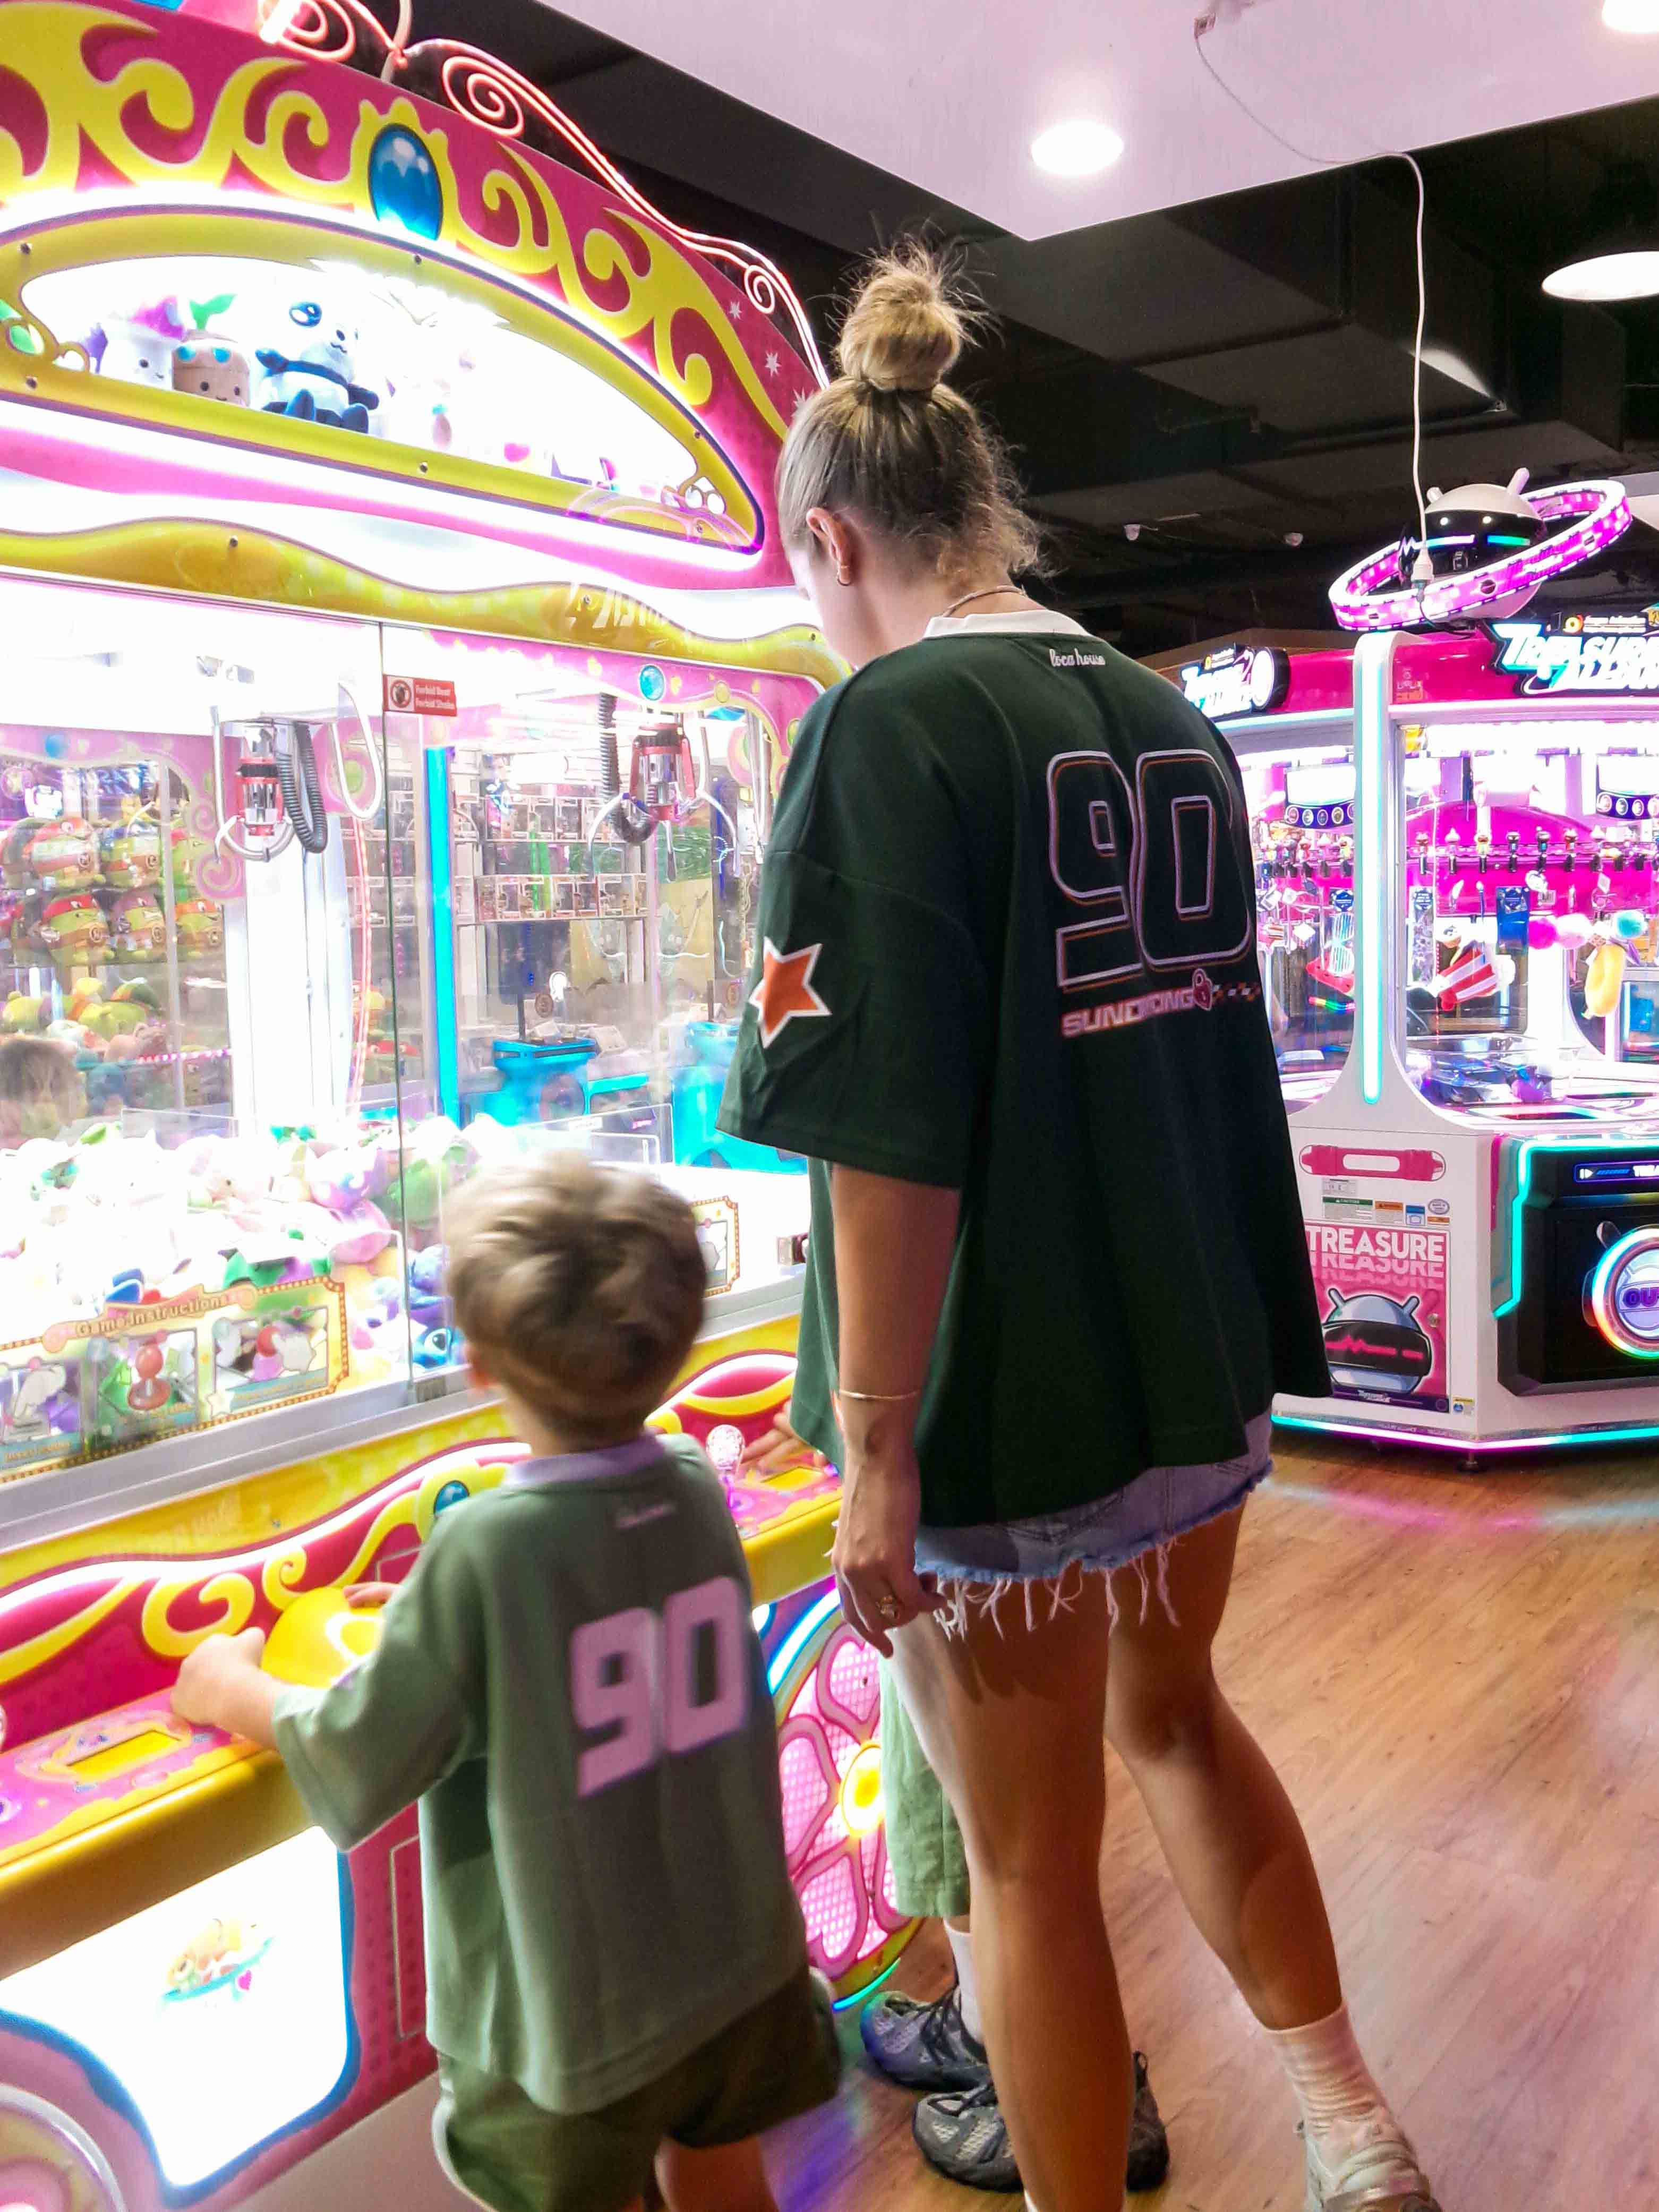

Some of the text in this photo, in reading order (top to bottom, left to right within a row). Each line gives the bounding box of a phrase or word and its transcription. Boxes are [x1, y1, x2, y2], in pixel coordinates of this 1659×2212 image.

[1048, 749, 1251, 992] 90
[1305, 1226, 1444, 1262] TREASURE
[571, 1575, 745, 1797] 90
